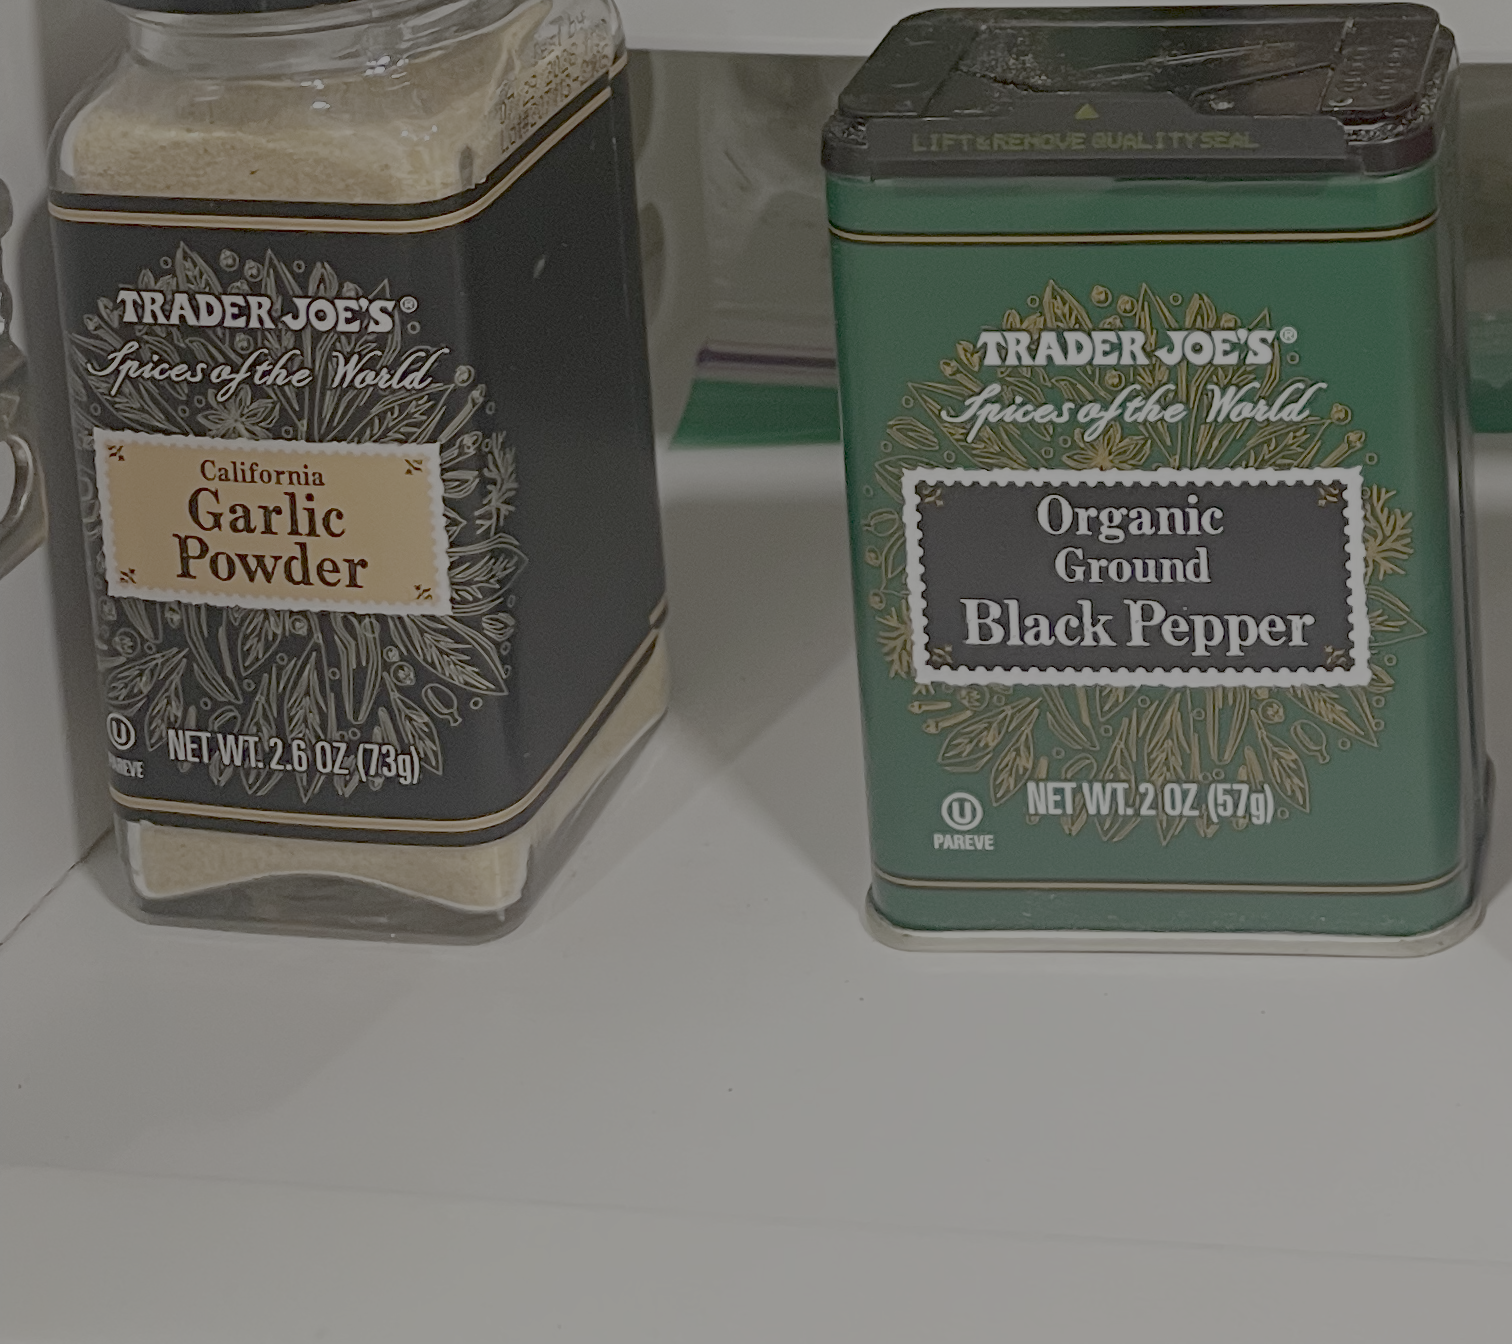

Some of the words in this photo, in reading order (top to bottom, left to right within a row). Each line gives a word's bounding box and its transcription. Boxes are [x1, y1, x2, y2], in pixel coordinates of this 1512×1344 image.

[913, 133, 974, 151] LIFT
[992, 133, 1086, 151] REMOVE
[1092, 132, 1201, 150] QUALITY
[1201, 132, 1259, 149] SEAL
[117, 290, 276, 330] TRADER
[88, 342, 206, 395] Spices
[330, 347, 450, 390] World
[977, 330, 1149, 366] TRADER
[941, 384, 1071, 442] Spices
[1203, 382, 1327, 424] World
[200, 460, 325, 487] California
[189, 487, 346, 538] Garlic
[1037, 494, 1224, 543] Organic
[173, 534, 368, 590] Powder
[1055, 547, 1212, 584] Ground
[960, 597, 1117, 647] Black
[1126, 599, 1315, 656] Pepper
[167, 730, 210, 764] NET
[218, 732, 264, 769] WT.
[268, 736, 308, 773] 2.6
[316, 740, 350, 777] OZ
[357, 743, 420, 785] (73g)
[1027, 782, 1076, 816] NET
[1083, 783, 1133, 816] WT.
[1138, 783, 1156, 815] 2
[1163, 783, 1198, 816] OZ
[1207, 784, 1274, 825] (57g)
[933, 834, 994, 851] PAREVE
